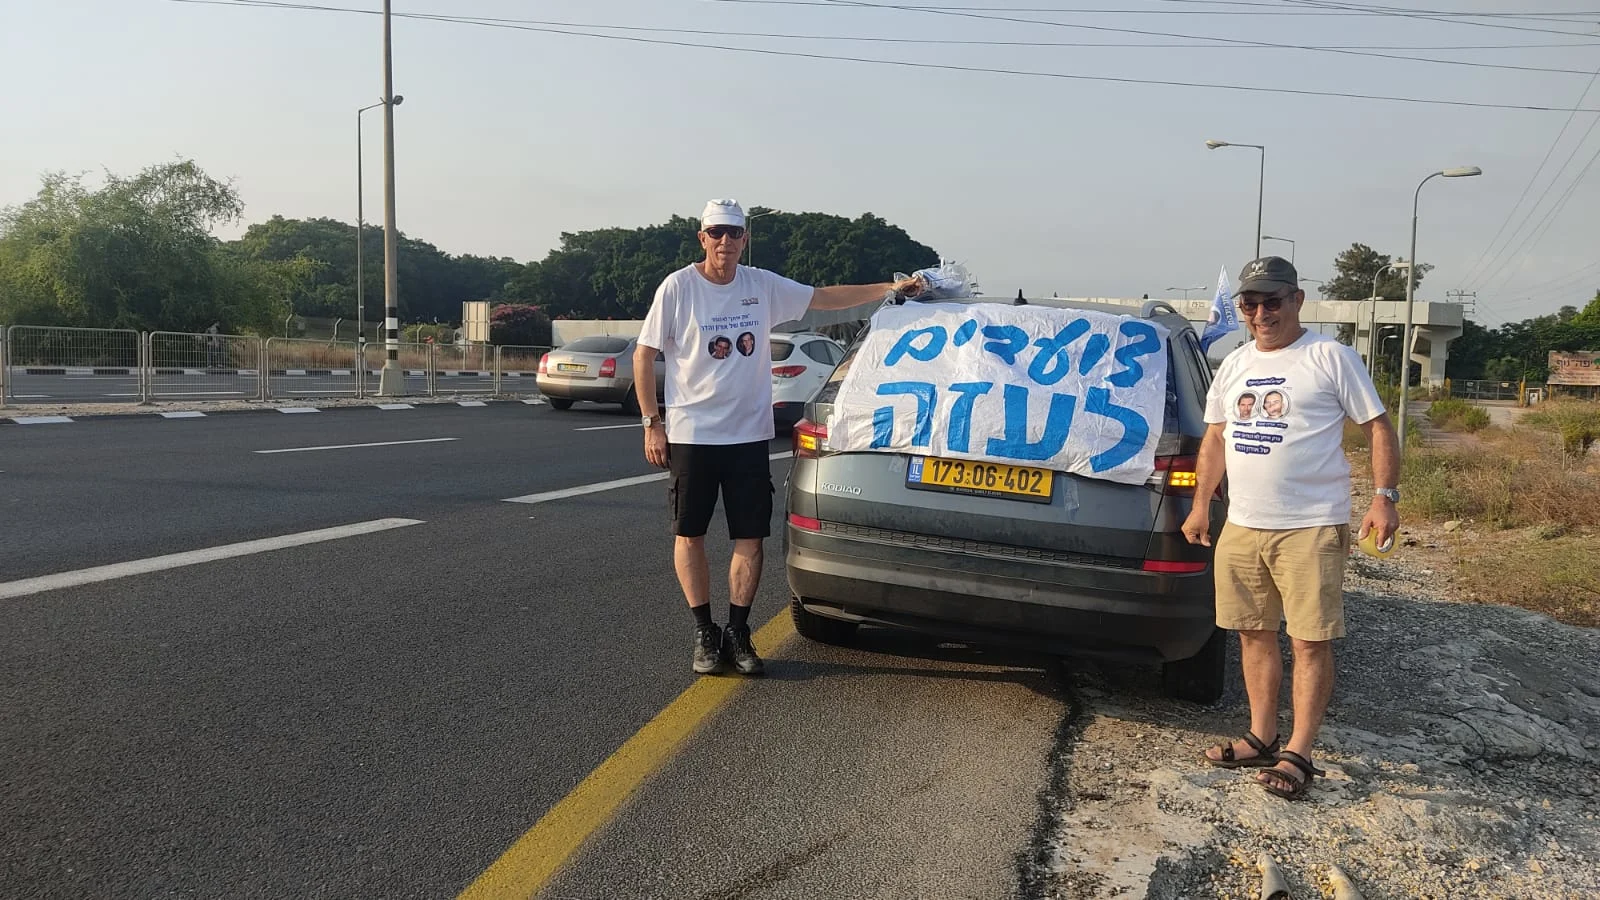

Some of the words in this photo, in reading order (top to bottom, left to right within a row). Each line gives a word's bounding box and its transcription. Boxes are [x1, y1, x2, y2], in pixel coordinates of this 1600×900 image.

[884, 318, 1161, 387] צועדים
[870, 382, 1150, 473] לעזה
[820, 482, 862, 496] KODIAQ
[911, 463, 920, 475] IL
